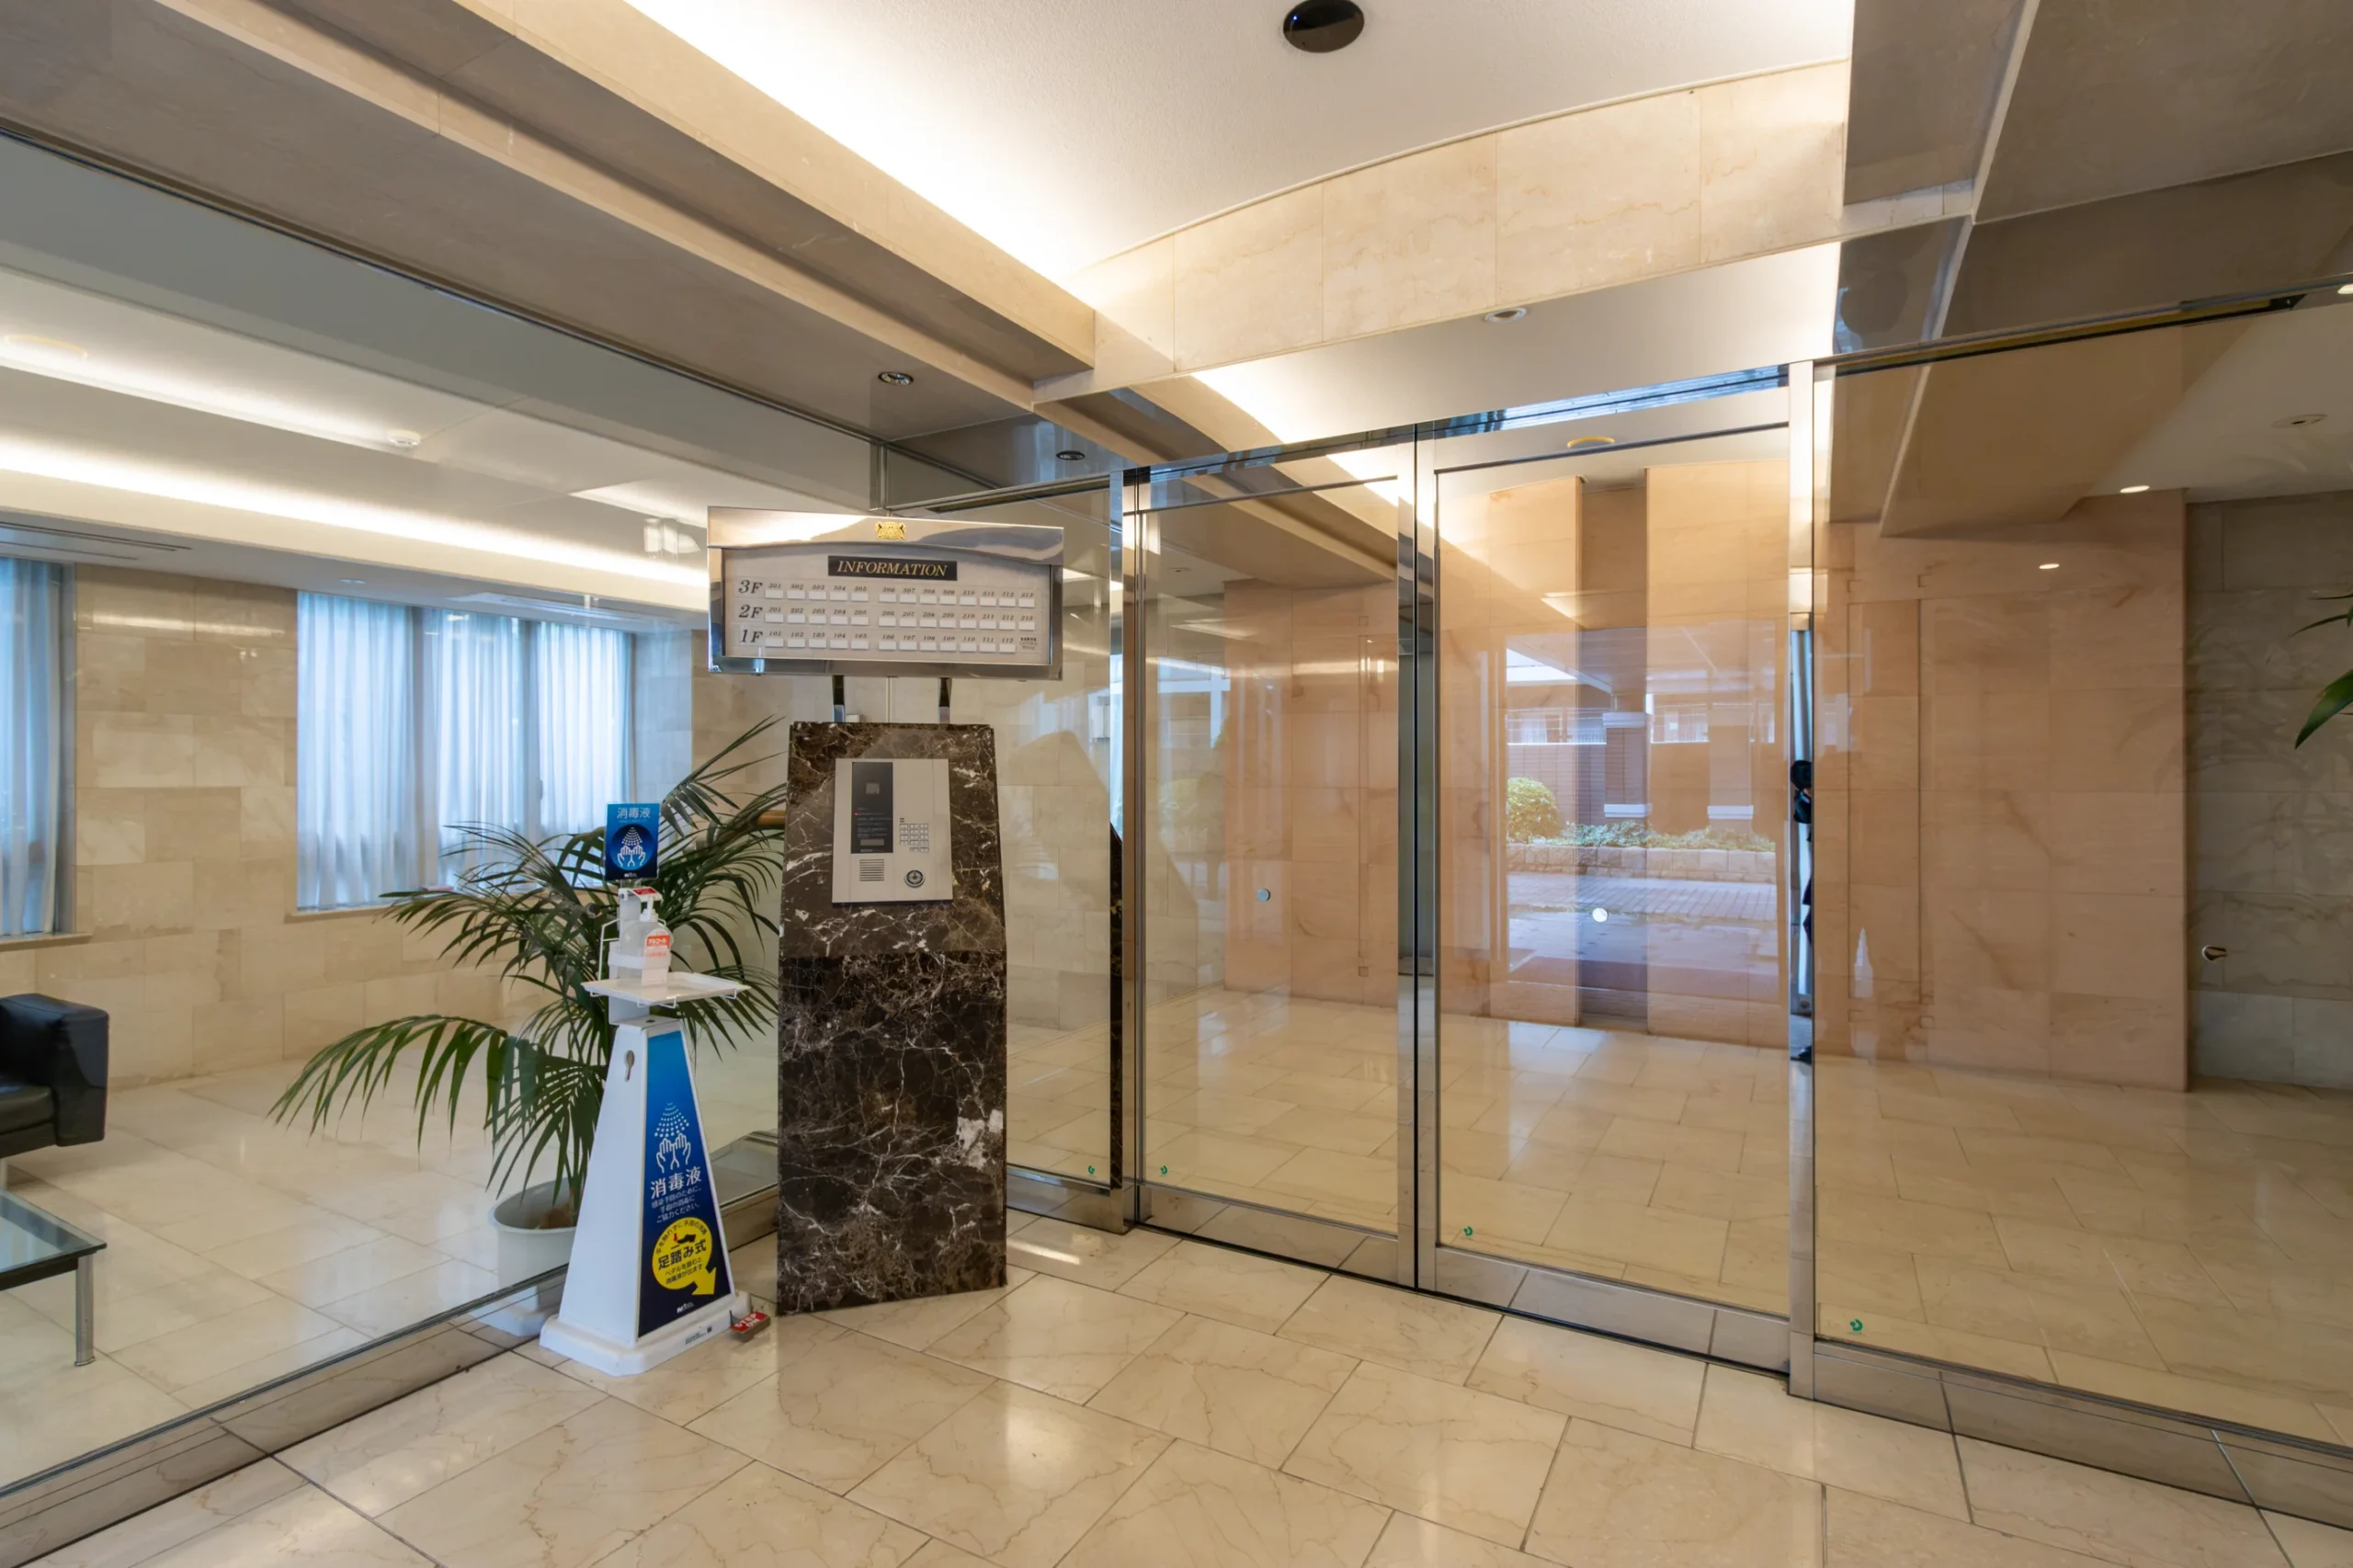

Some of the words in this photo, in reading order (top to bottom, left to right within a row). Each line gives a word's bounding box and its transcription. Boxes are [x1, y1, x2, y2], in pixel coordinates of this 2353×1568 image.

[837, 561, 948, 576] INFORMATION
[738, 580, 763, 594] 3F
[738, 605, 763, 618] 2F
[740, 630, 763, 643] 1F
[617, 807, 651, 819] 消毒液
[650, 1166, 701, 1199] 消毒液
[658, 1238, 706, 1270] 足踏み式
[734, 1313, 756, 1328] STEP
